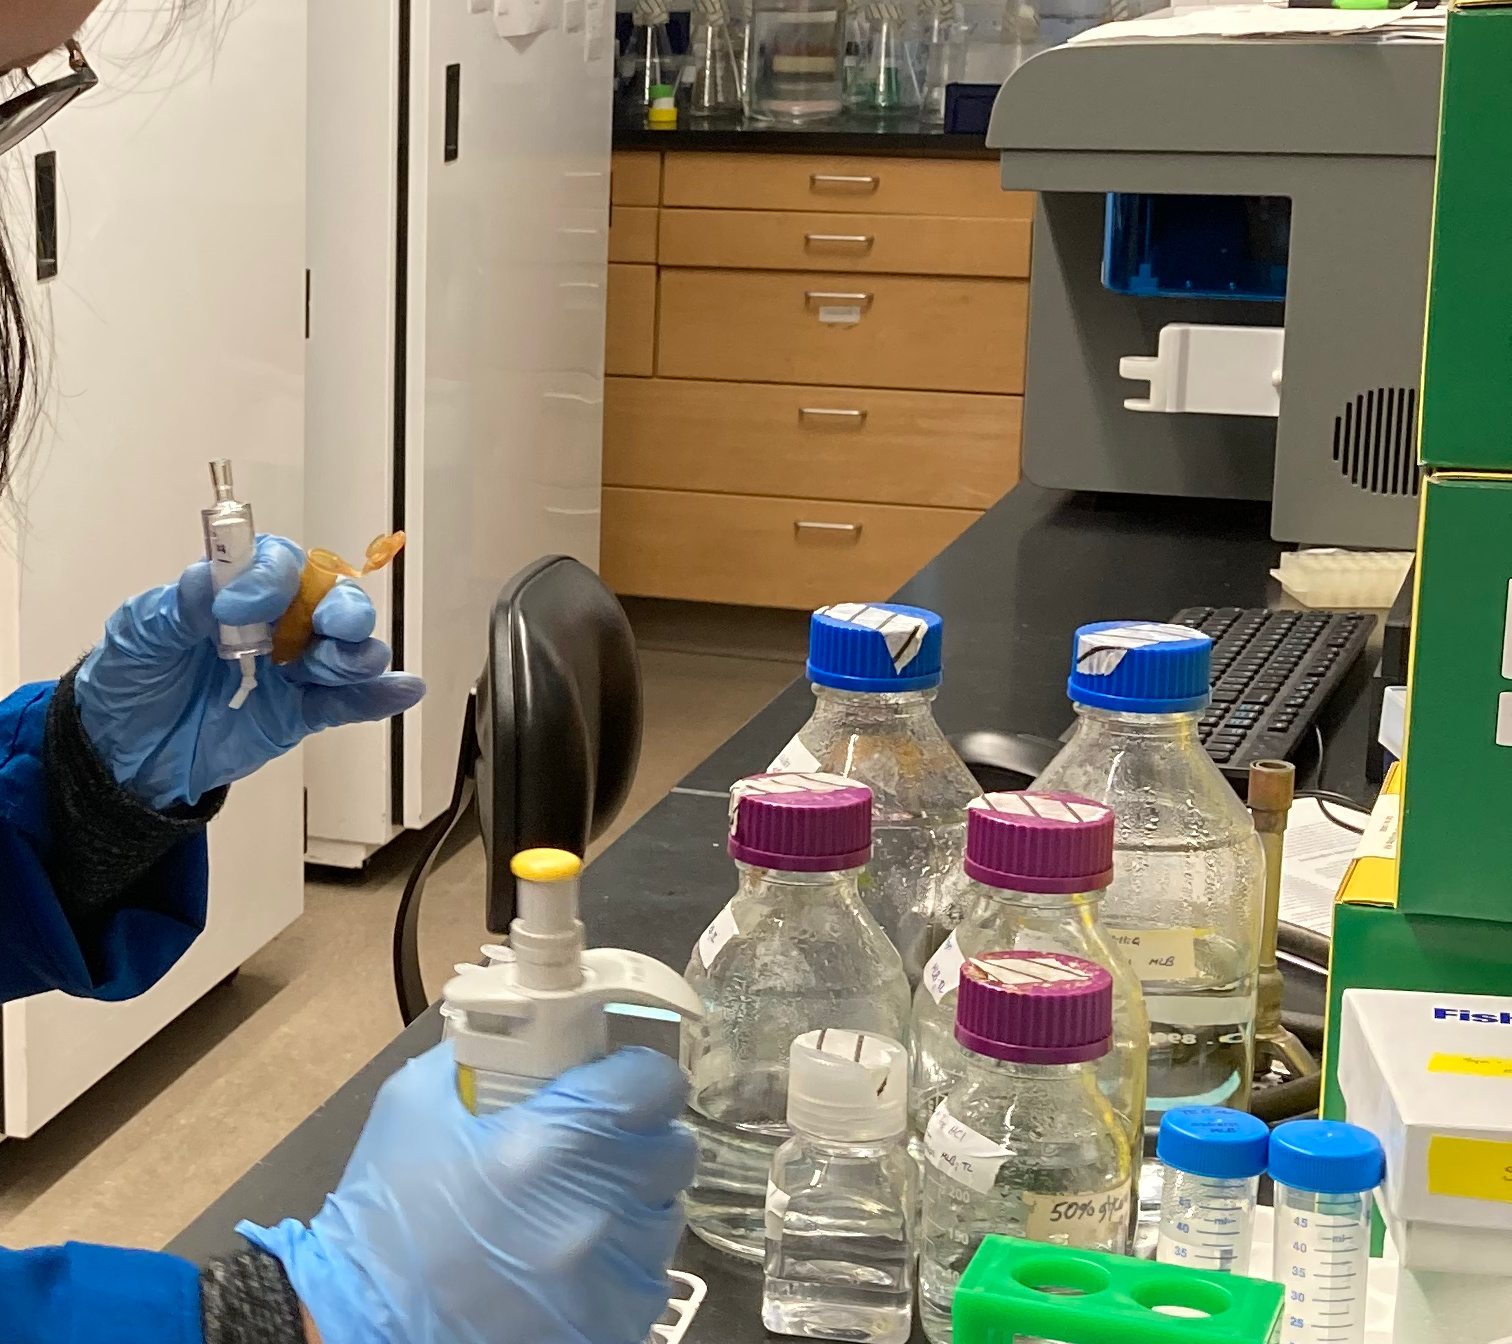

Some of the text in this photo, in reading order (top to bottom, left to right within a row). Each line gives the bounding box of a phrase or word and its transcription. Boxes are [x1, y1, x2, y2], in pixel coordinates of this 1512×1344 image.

[1049, 1199, 1095, 1223] 50%
[1293, 1216, 1308, 1228] 45
[1174, 1246, 1188, 1258] 35
[1292, 1242, 1308, 1254] 40
[1291, 1266, 1306, 1279] 35
[1290, 1291, 1305, 1303] 30
[1289, 1316, 1304, 1329] 25
